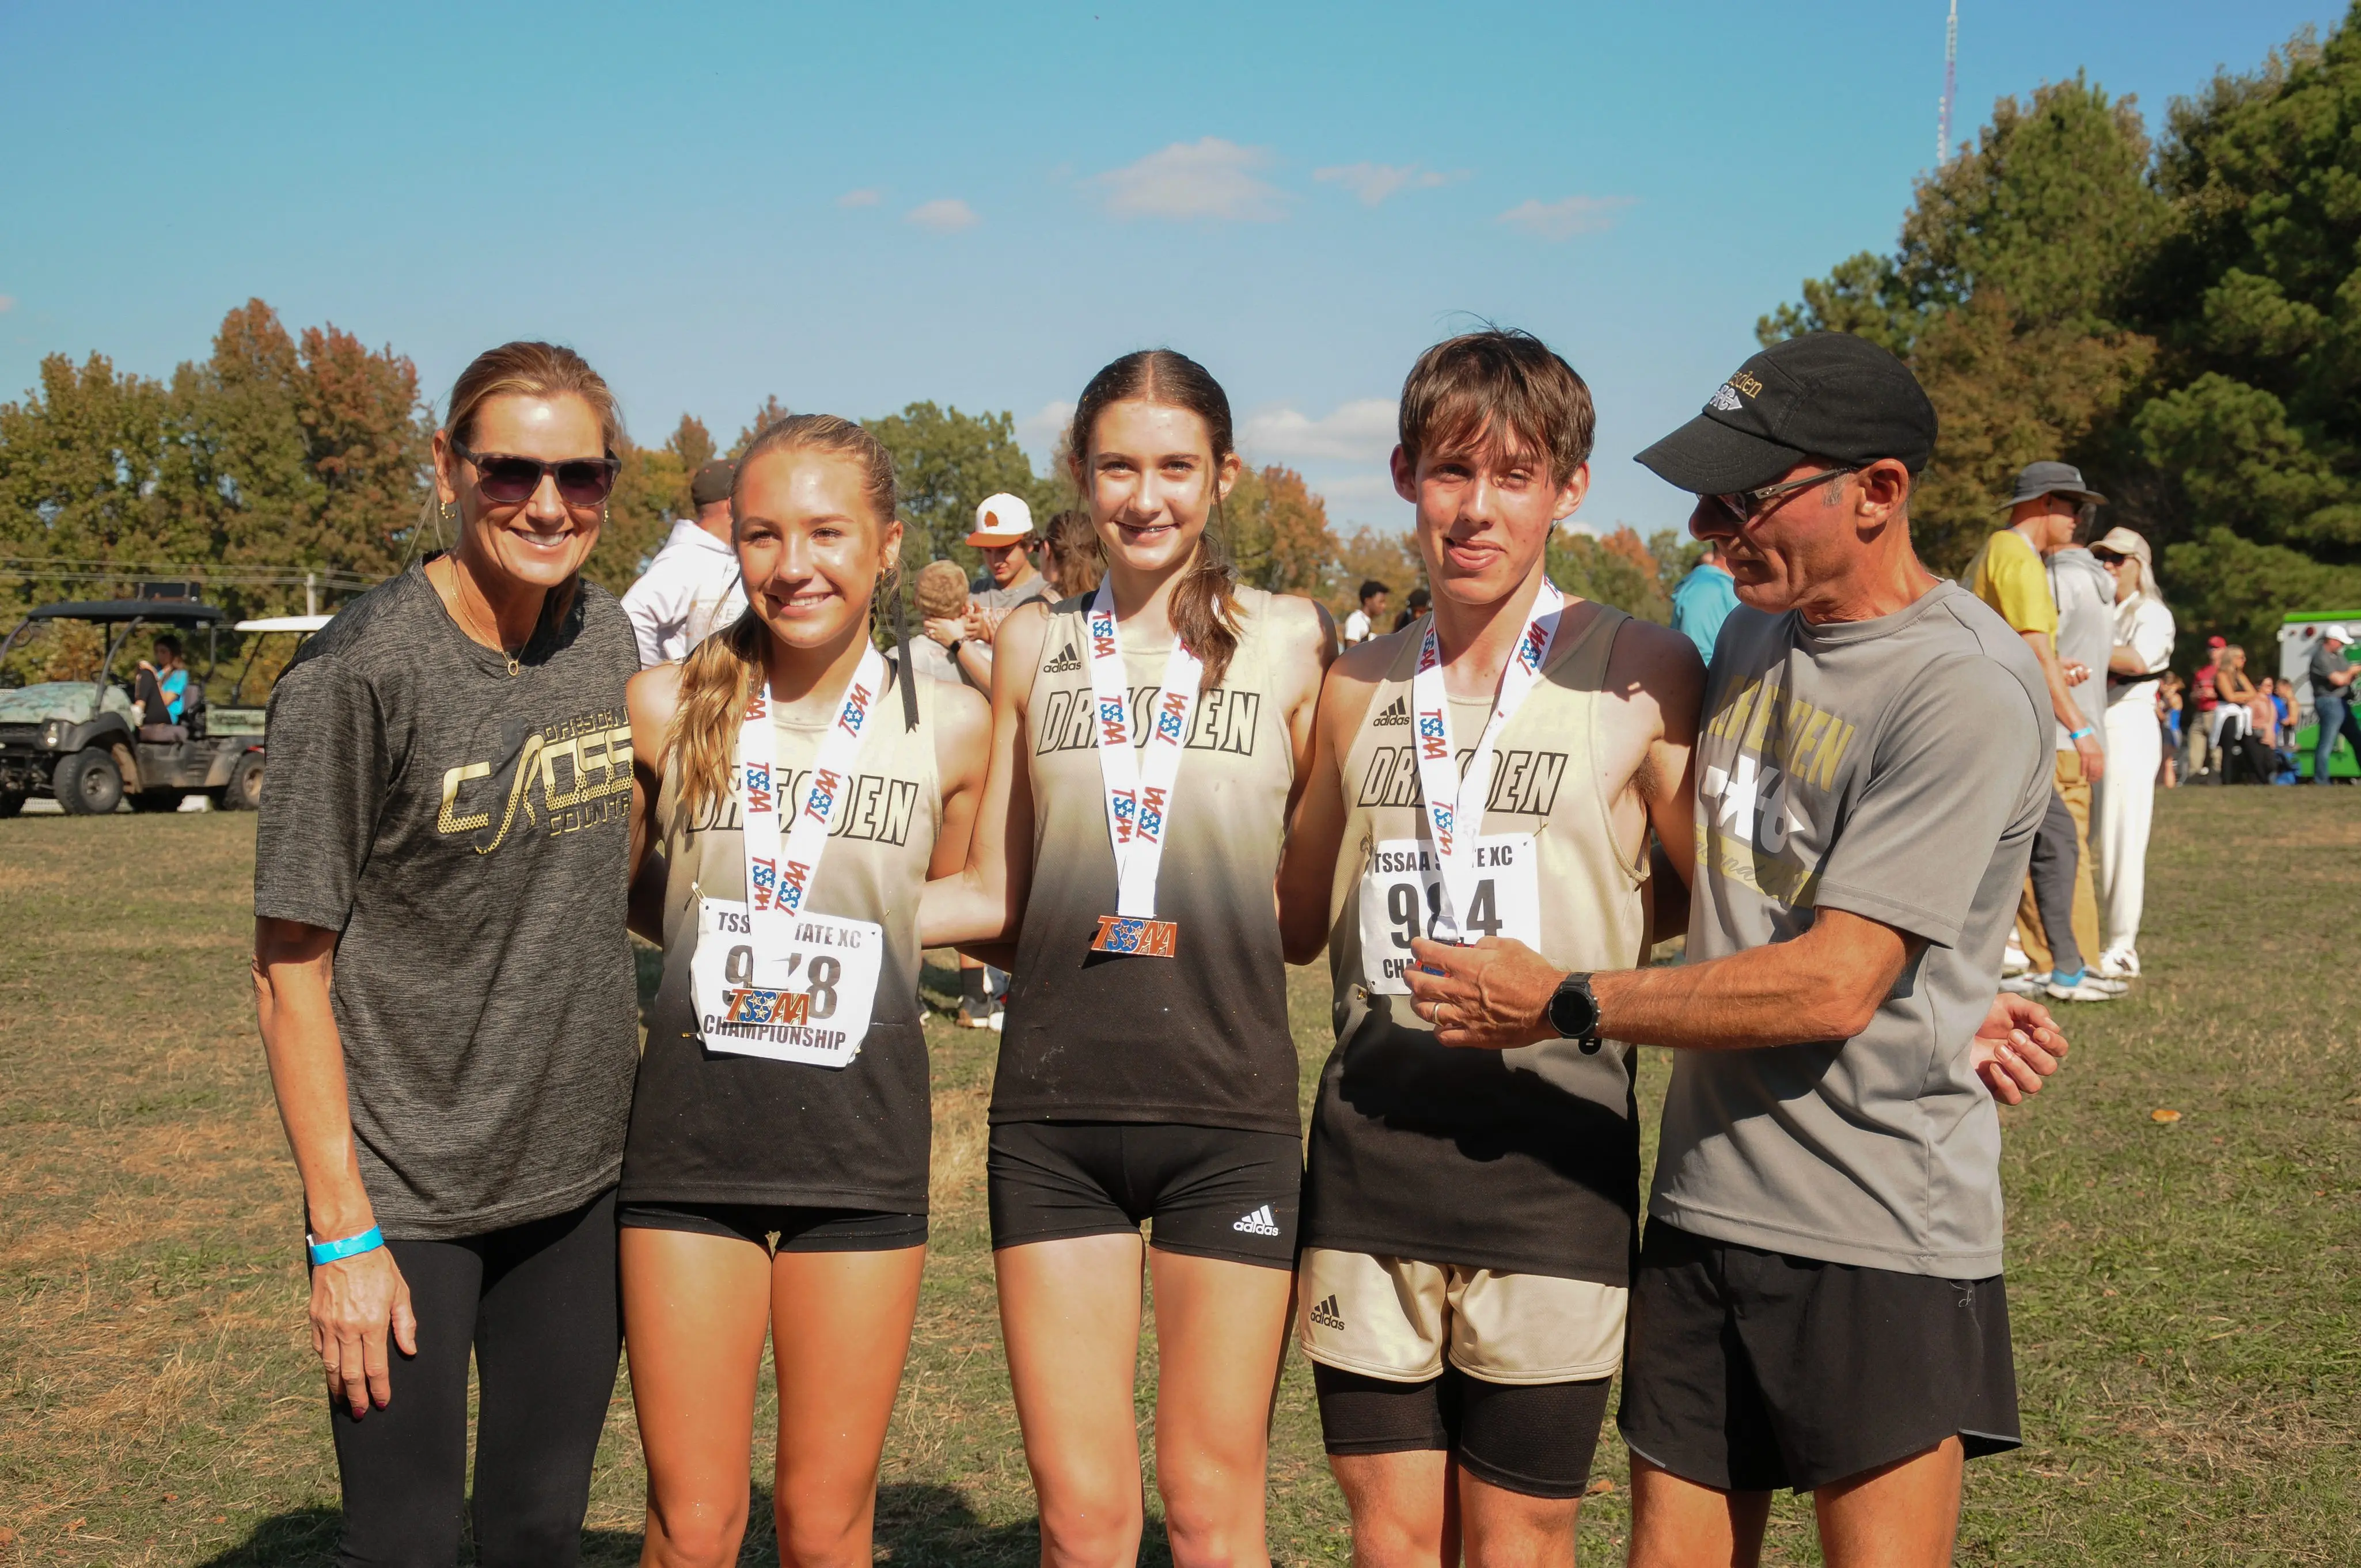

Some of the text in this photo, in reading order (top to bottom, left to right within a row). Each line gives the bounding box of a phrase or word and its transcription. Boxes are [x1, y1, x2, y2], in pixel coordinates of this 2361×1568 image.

[1043, 660, 1081, 673] adidas
[1373, 715, 1410, 727] adidas
[549, 795, 631, 836] COUNTR
[1375, 851, 1430, 873] TSSAA
[1490, 845, 1513, 866] XC
[837, 929, 861, 949] XC
[703, 1014, 847, 1050] CHAMPIONSHIP
[1233, 1221, 1279, 1236] adidas
[1310, 1311, 1345, 1331] adidas
